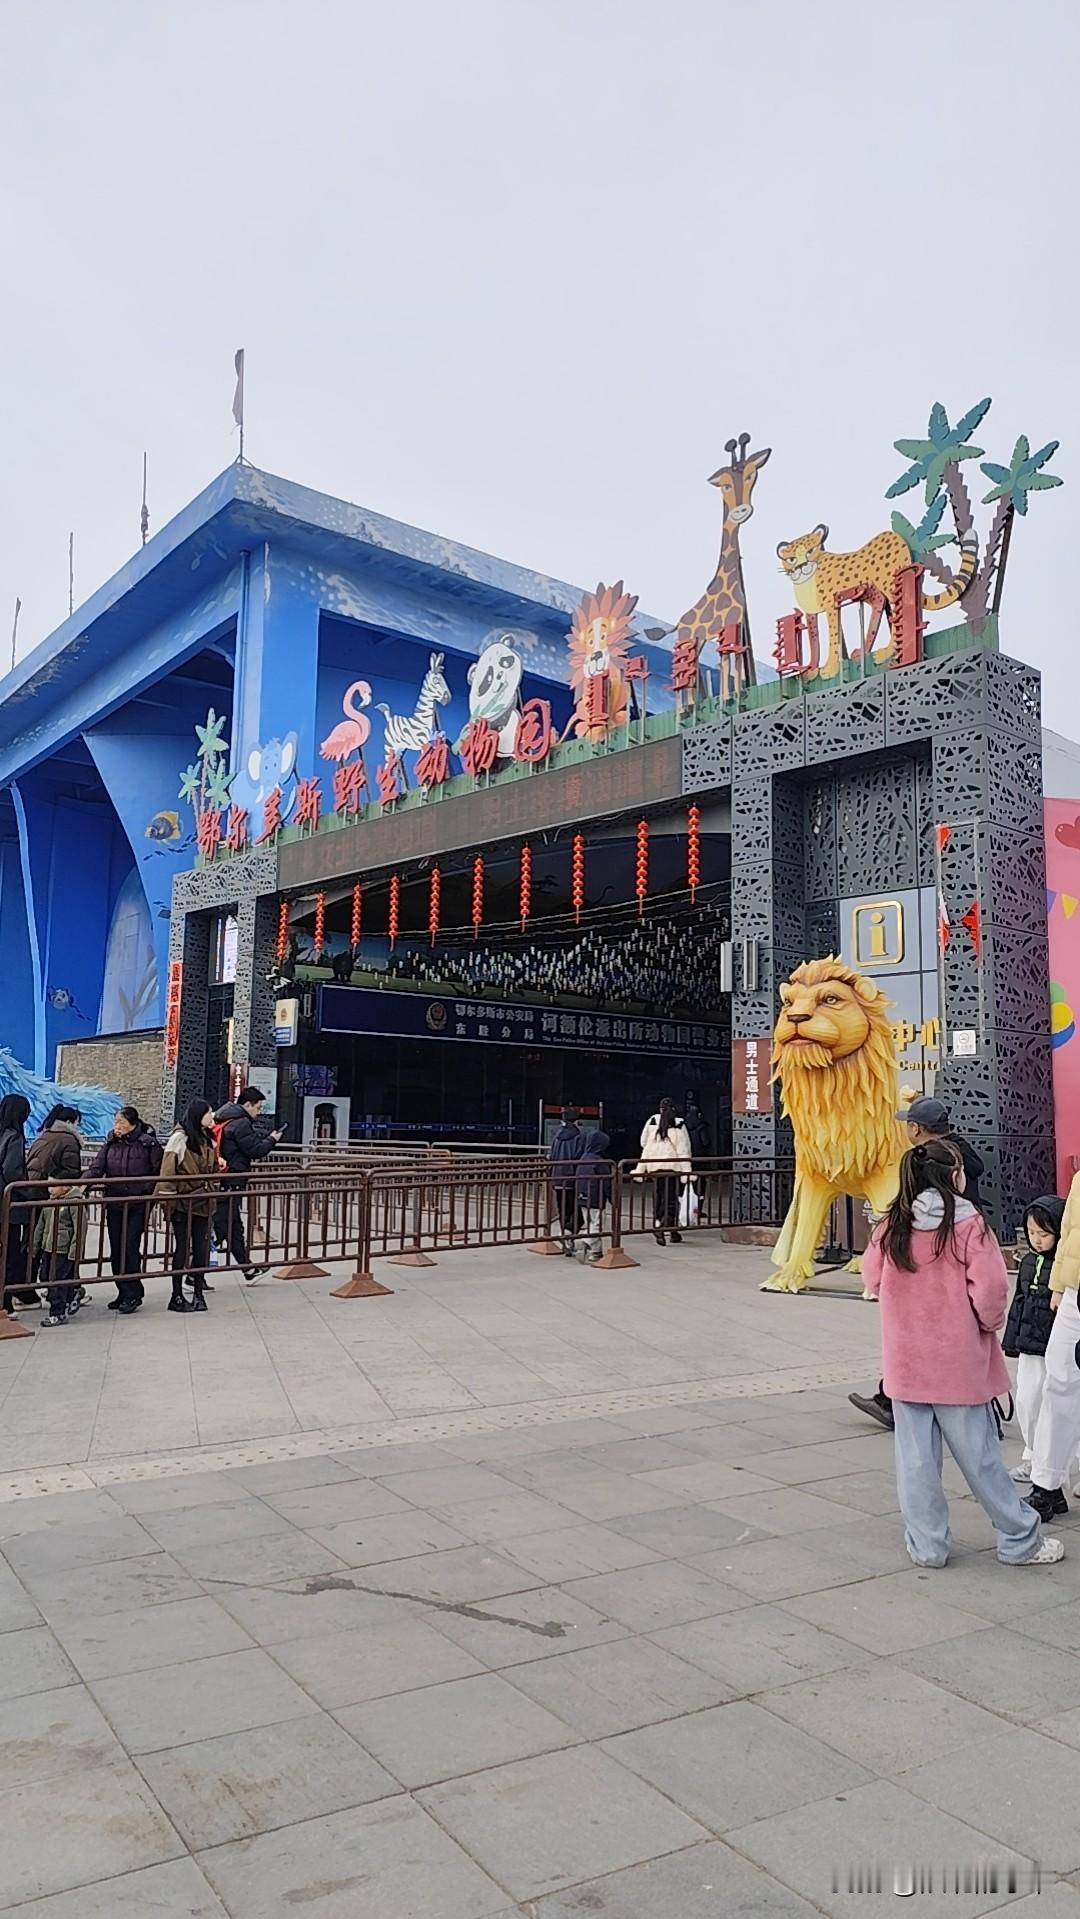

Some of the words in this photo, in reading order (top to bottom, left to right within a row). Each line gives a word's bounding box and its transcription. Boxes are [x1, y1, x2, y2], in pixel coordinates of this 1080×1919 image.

[197, 698, 551, 860] 鄂尔多斯野生动物园
[455, 1003, 535, 1023] 鄂尔多斯市公安局
[455, 1022, 535, 1040] 东胜分局
[745, 1041, 759, 1111] 男士通道
